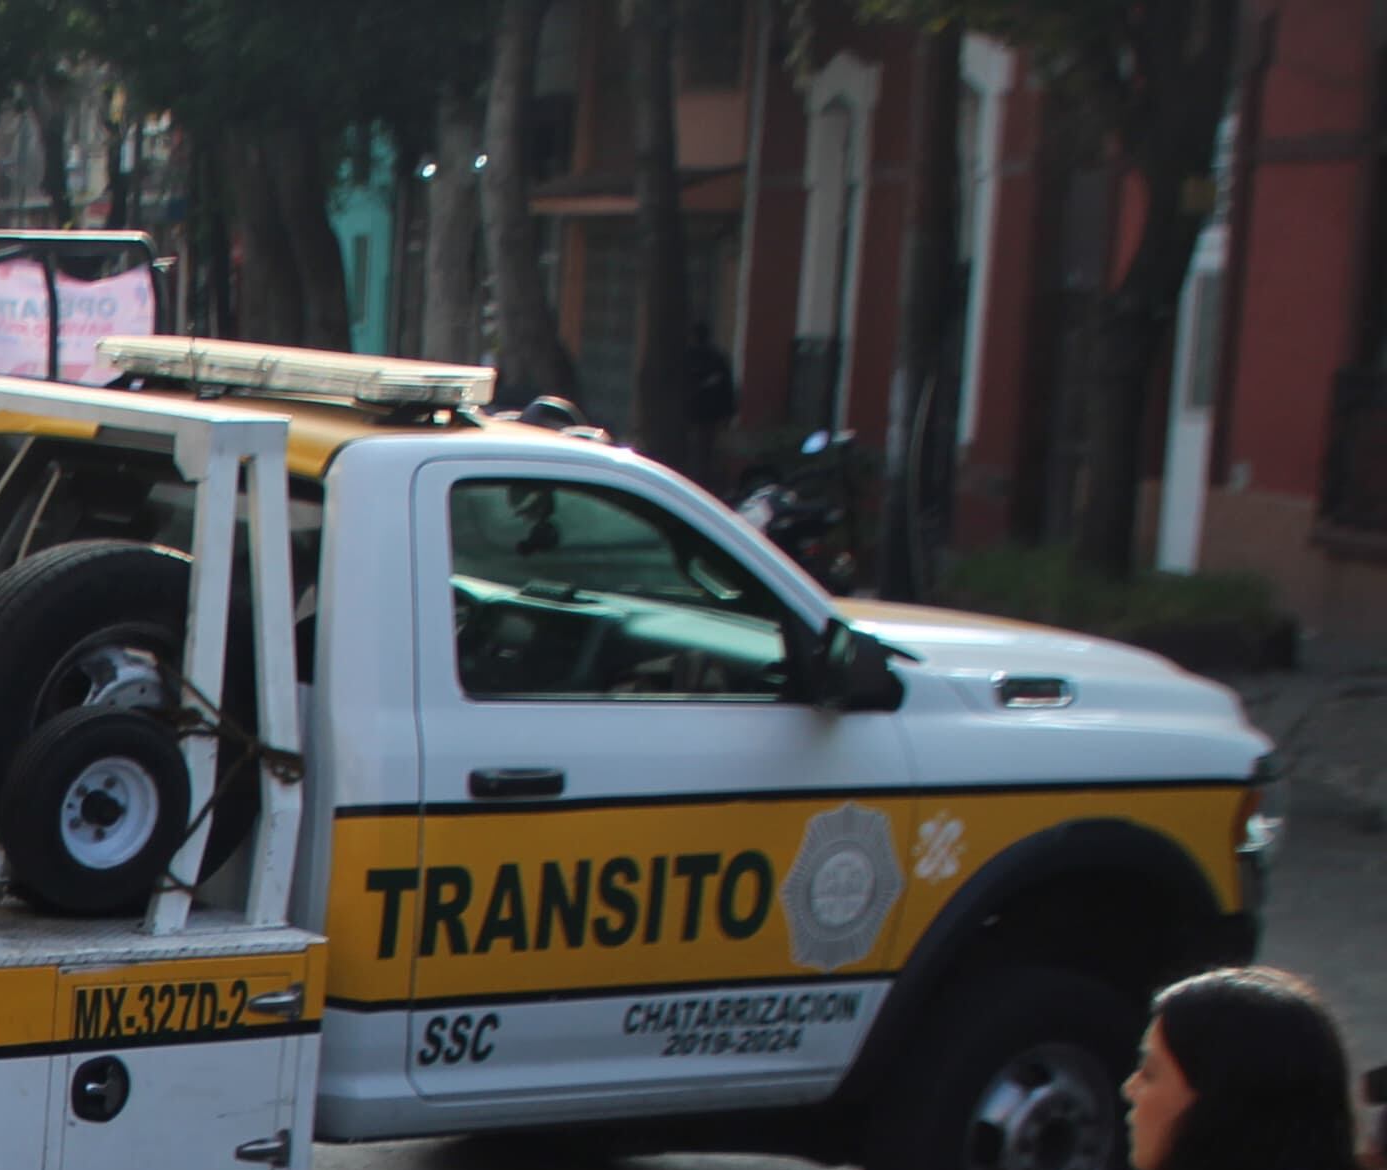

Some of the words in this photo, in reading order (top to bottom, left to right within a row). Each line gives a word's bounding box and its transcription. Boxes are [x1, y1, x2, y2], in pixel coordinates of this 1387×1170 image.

[365, 849, 775, 960] TRANSITO
[75, 980, 248, 1040] MX-327D-2
[418, 1012, 500, 1065] SSC
[661, 1028, 804, 1057] 2019-2024
